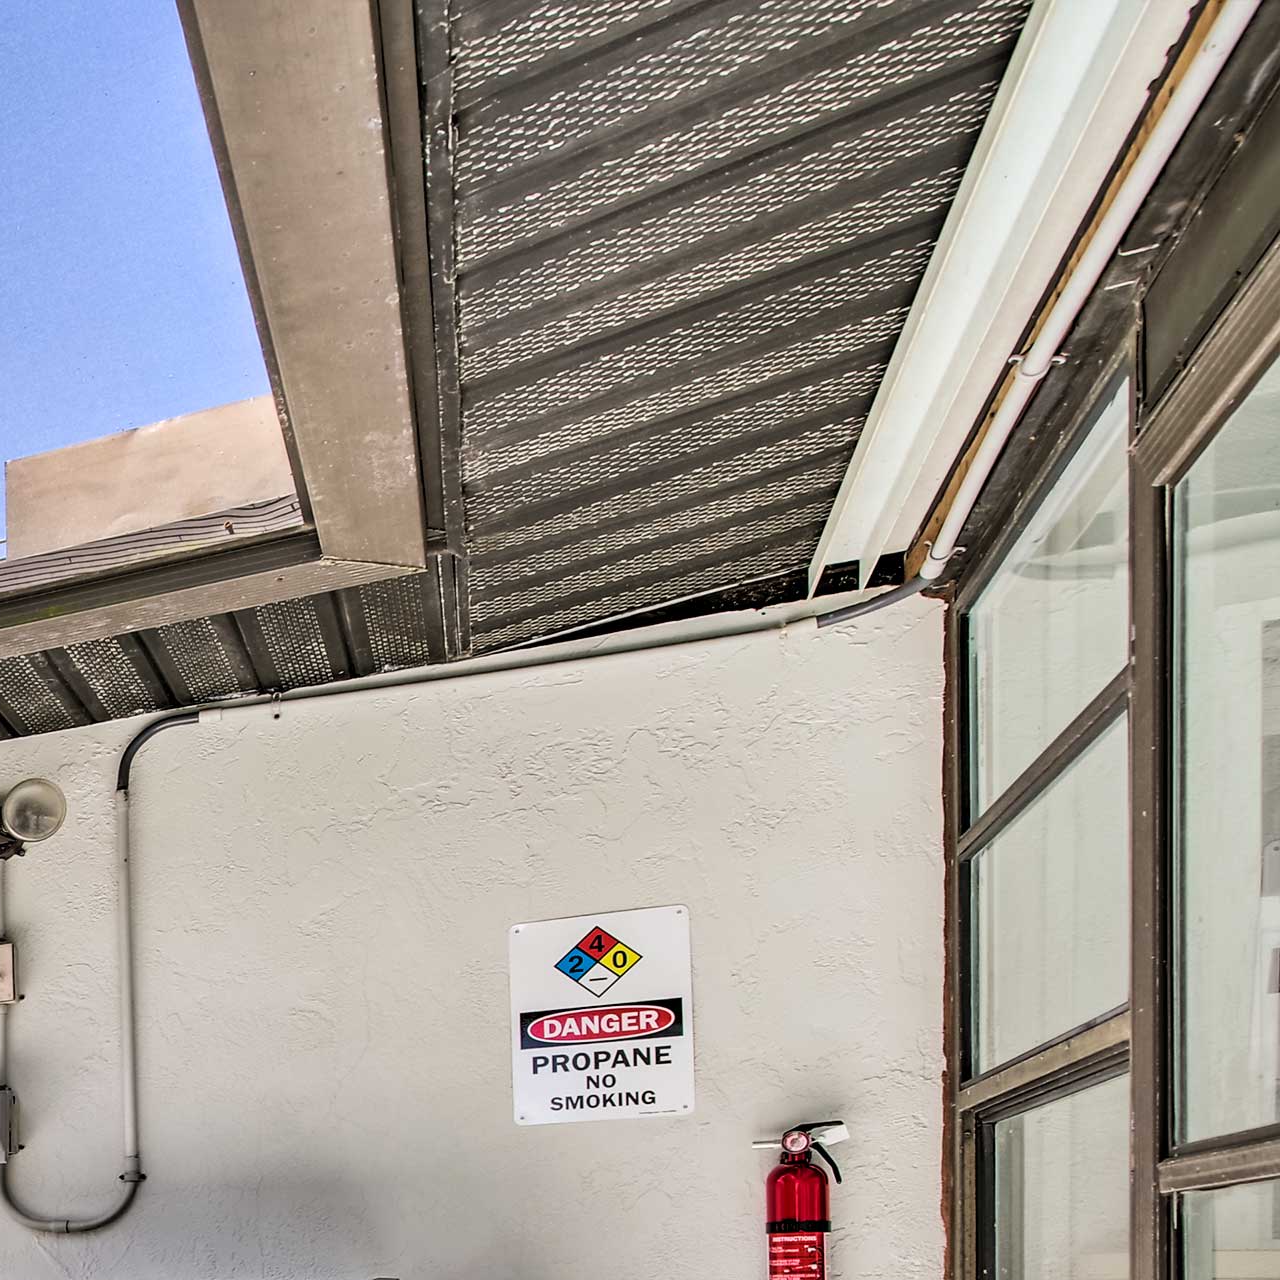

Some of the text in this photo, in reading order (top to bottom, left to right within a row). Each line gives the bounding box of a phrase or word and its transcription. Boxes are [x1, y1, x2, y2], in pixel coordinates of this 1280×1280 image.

[589, 934, 605, 953] 4
[568, 955, 584, 973] 2
[612, 950, 627, 969] 0
[543, 1010, 660, 1039] DANGER
[532, 1045, 672, 1075] PROPANE
[586, 1074, 616, 1090] NO
[550, 1090, 656, 1111] SMOKING
